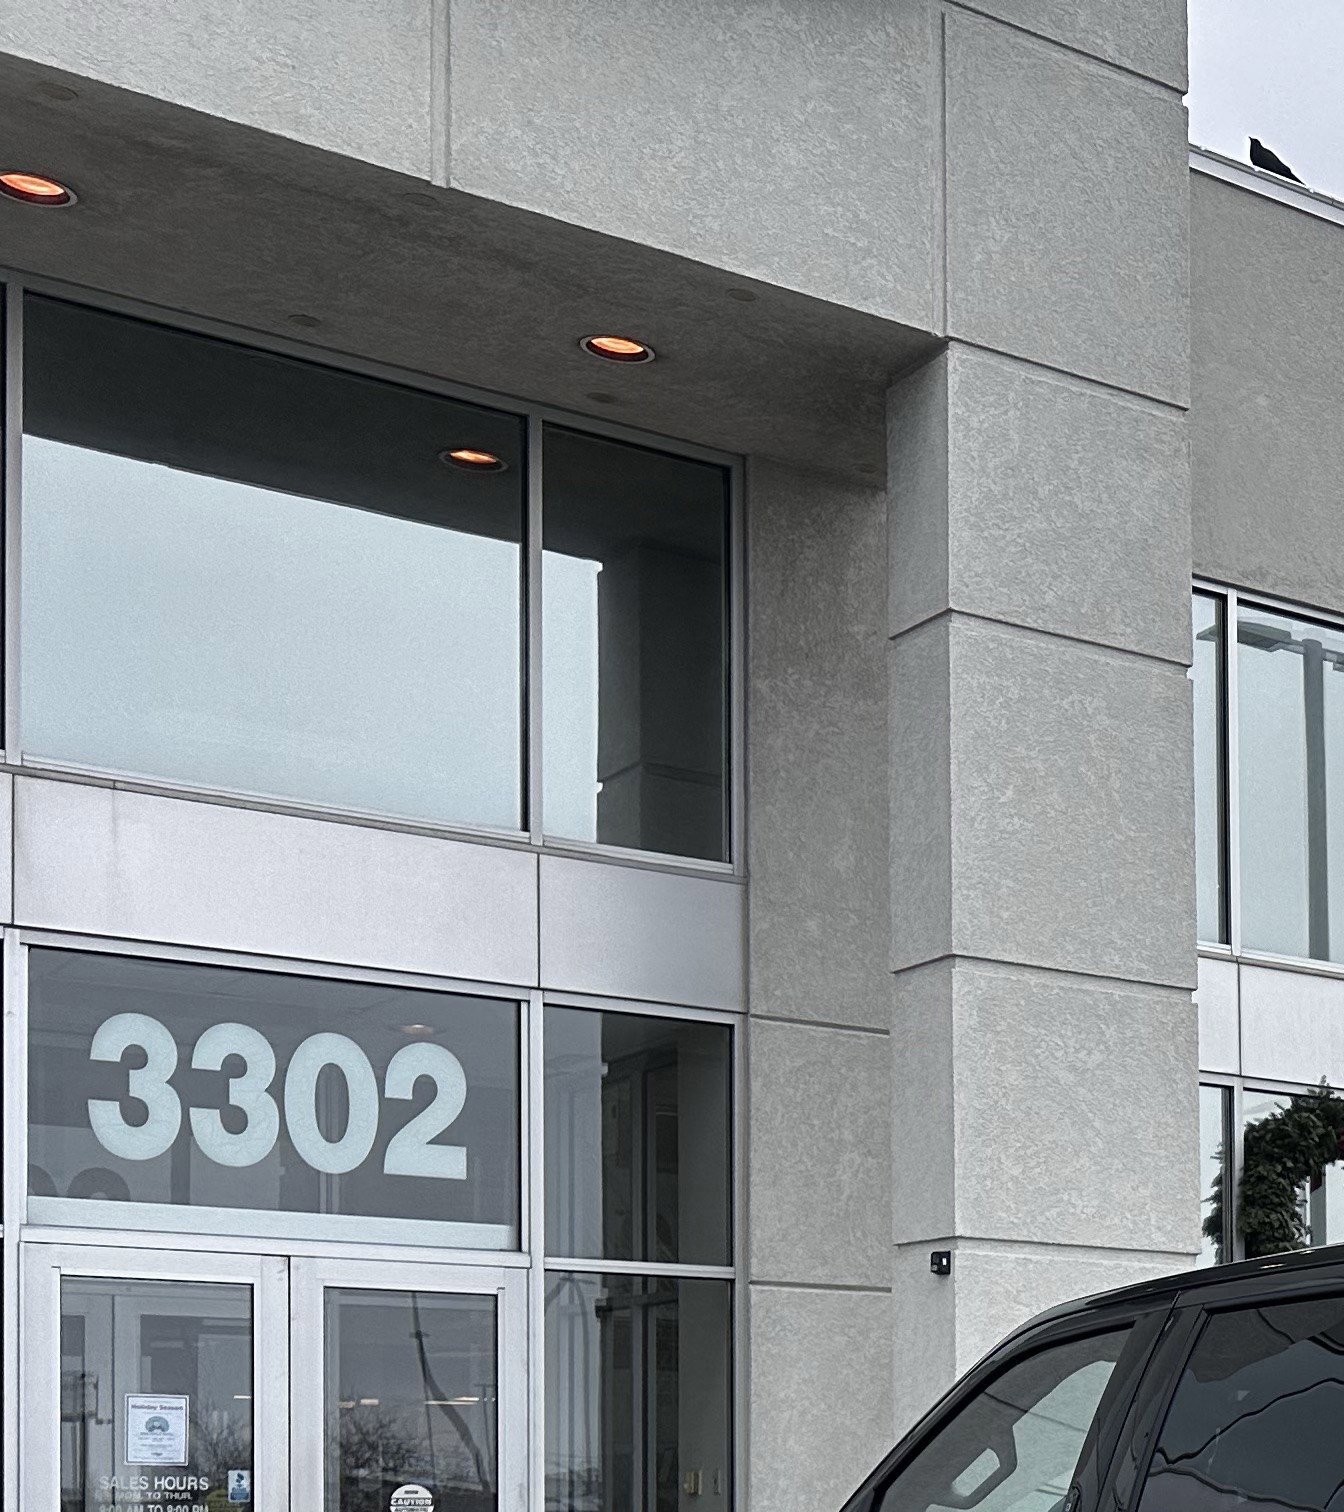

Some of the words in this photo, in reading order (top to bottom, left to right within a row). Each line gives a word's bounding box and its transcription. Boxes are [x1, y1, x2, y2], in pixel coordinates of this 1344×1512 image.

[88, 1012, 467, 1180] 3302
[99, 1476, 149, 1491] SALES
[154, 1476, 209, 1491] HOURS
[146, 1491, 161, 1500] TO
[390, 1498, 432, 1506] CAUTION
